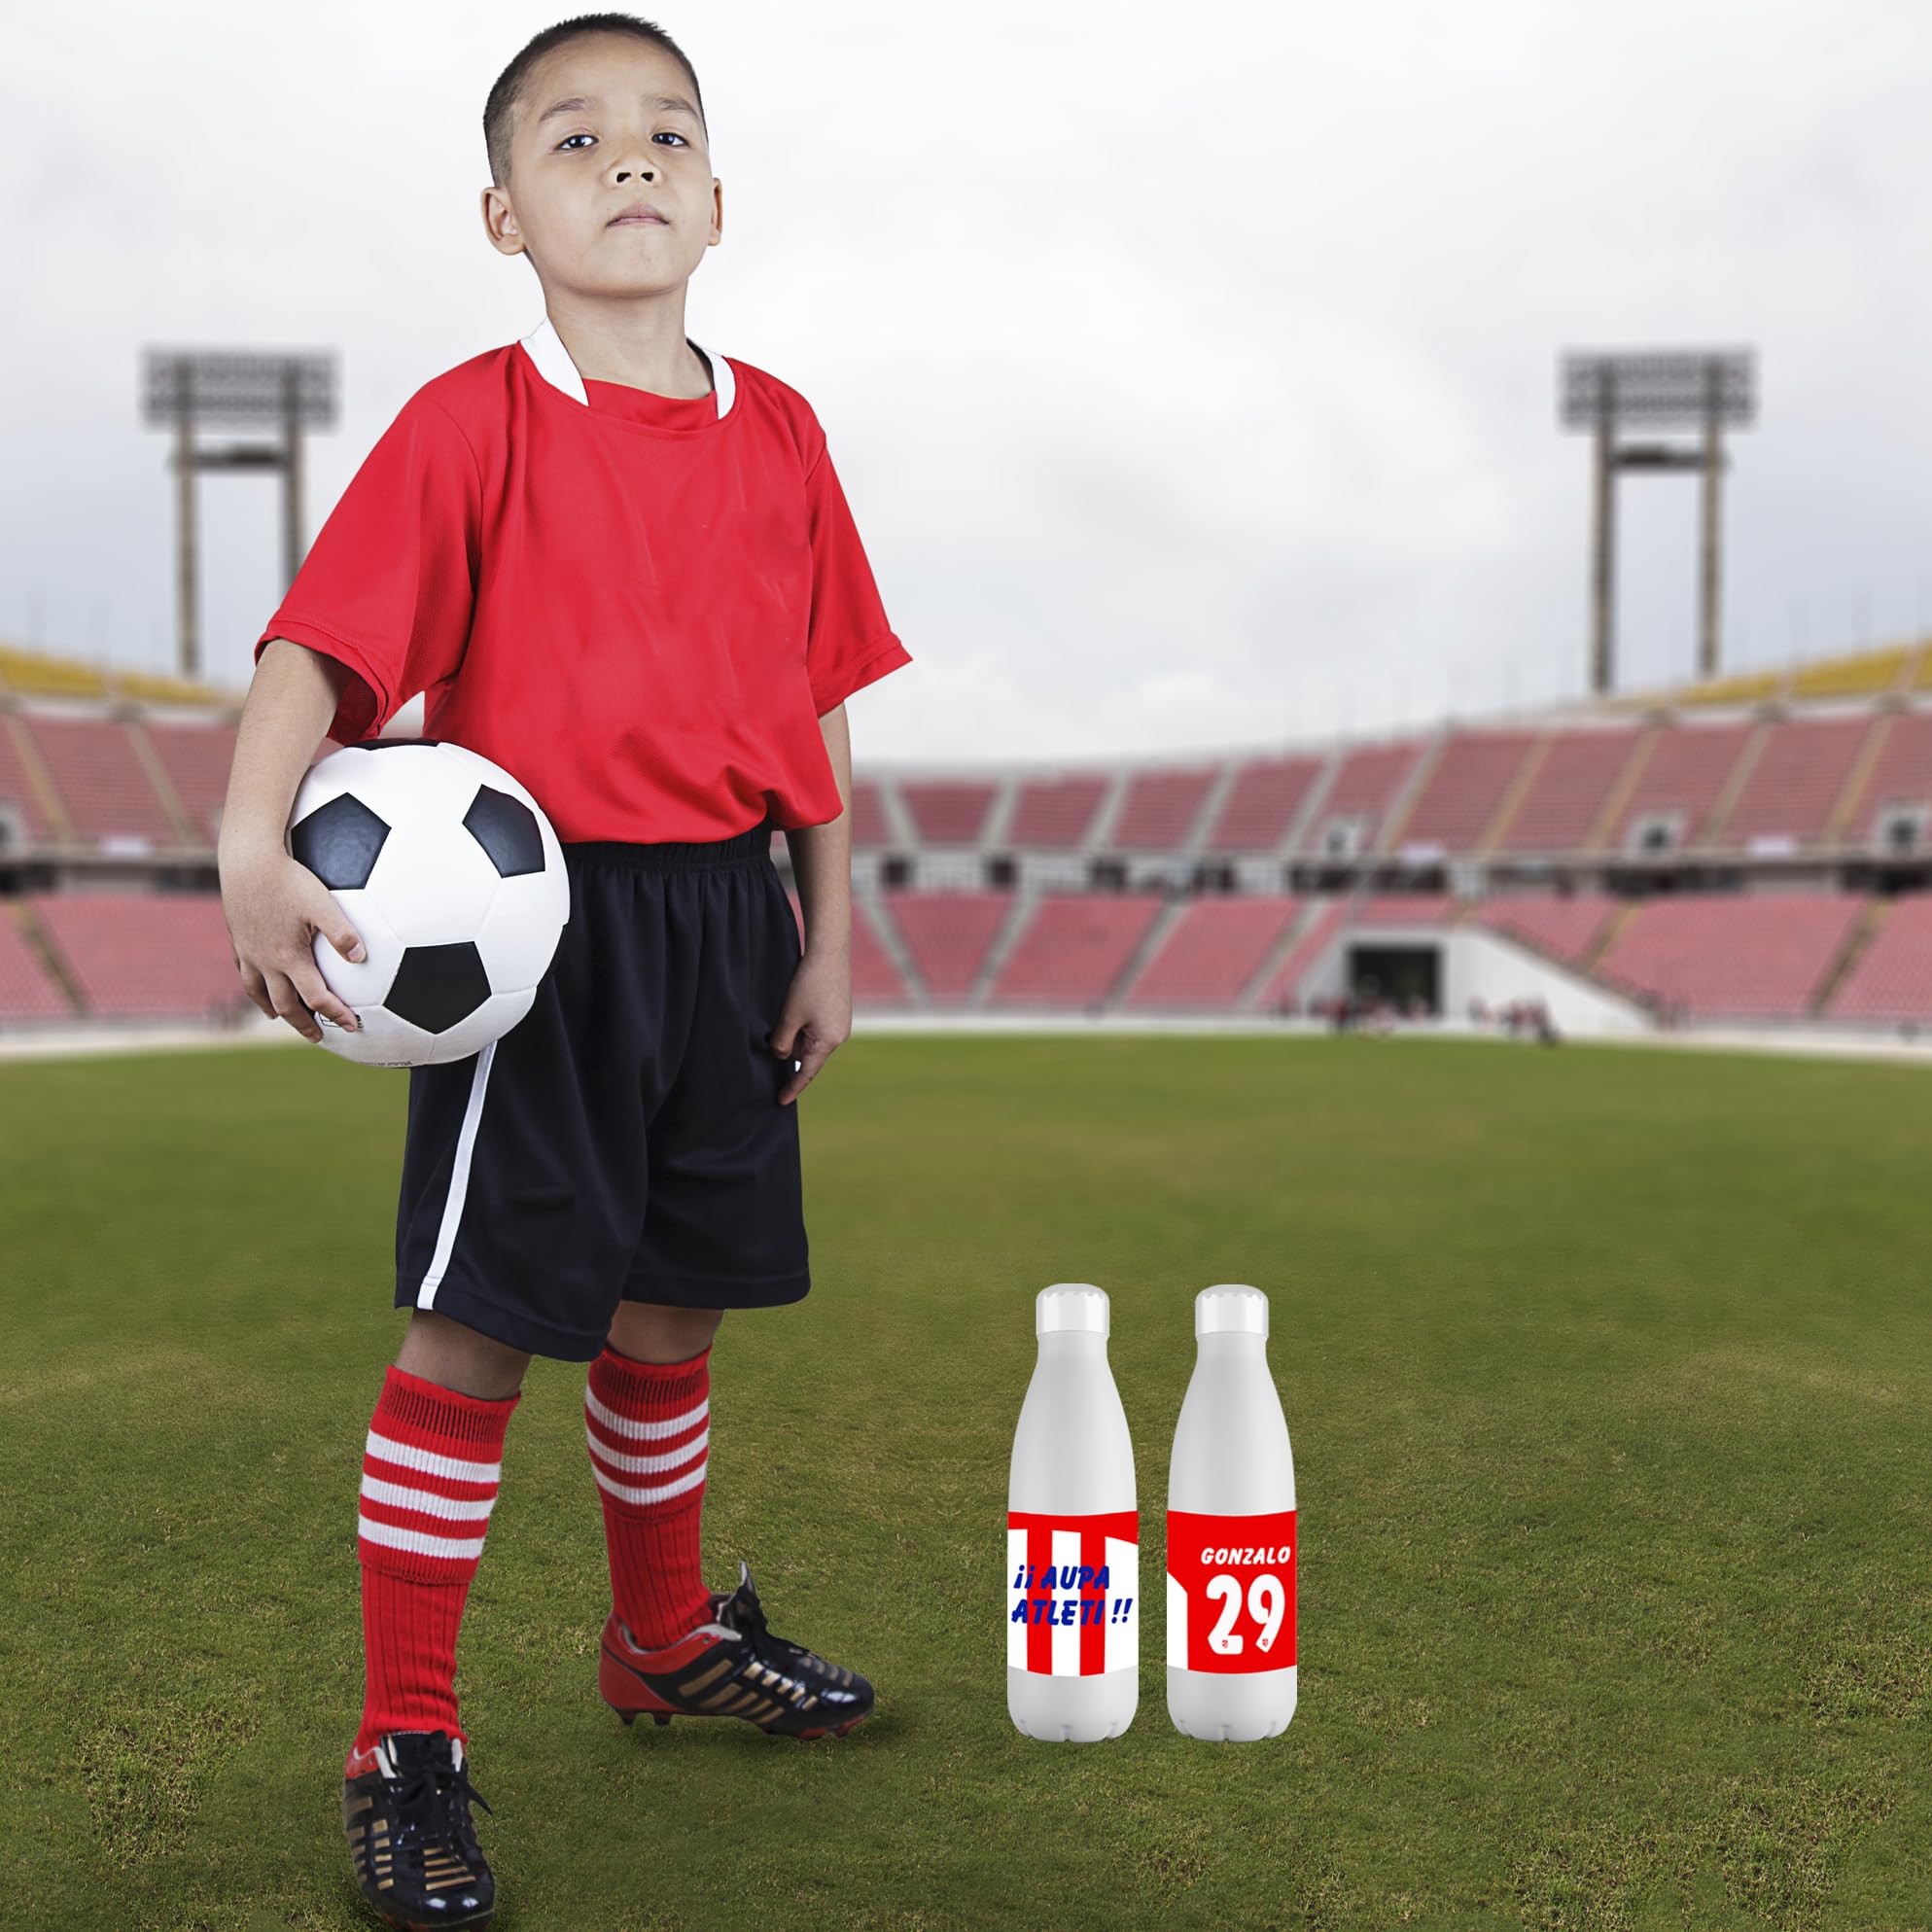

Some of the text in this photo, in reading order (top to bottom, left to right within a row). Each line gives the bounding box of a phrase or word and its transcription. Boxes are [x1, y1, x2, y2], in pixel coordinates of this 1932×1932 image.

[1200, 1546, 1291, 1564] GONZALO
[1040, 1565, 1110, 1590] AUPA
[1011, 1598, 1105, 1626] ATLETI
[1206, 1573, 1285, 1655] 29
